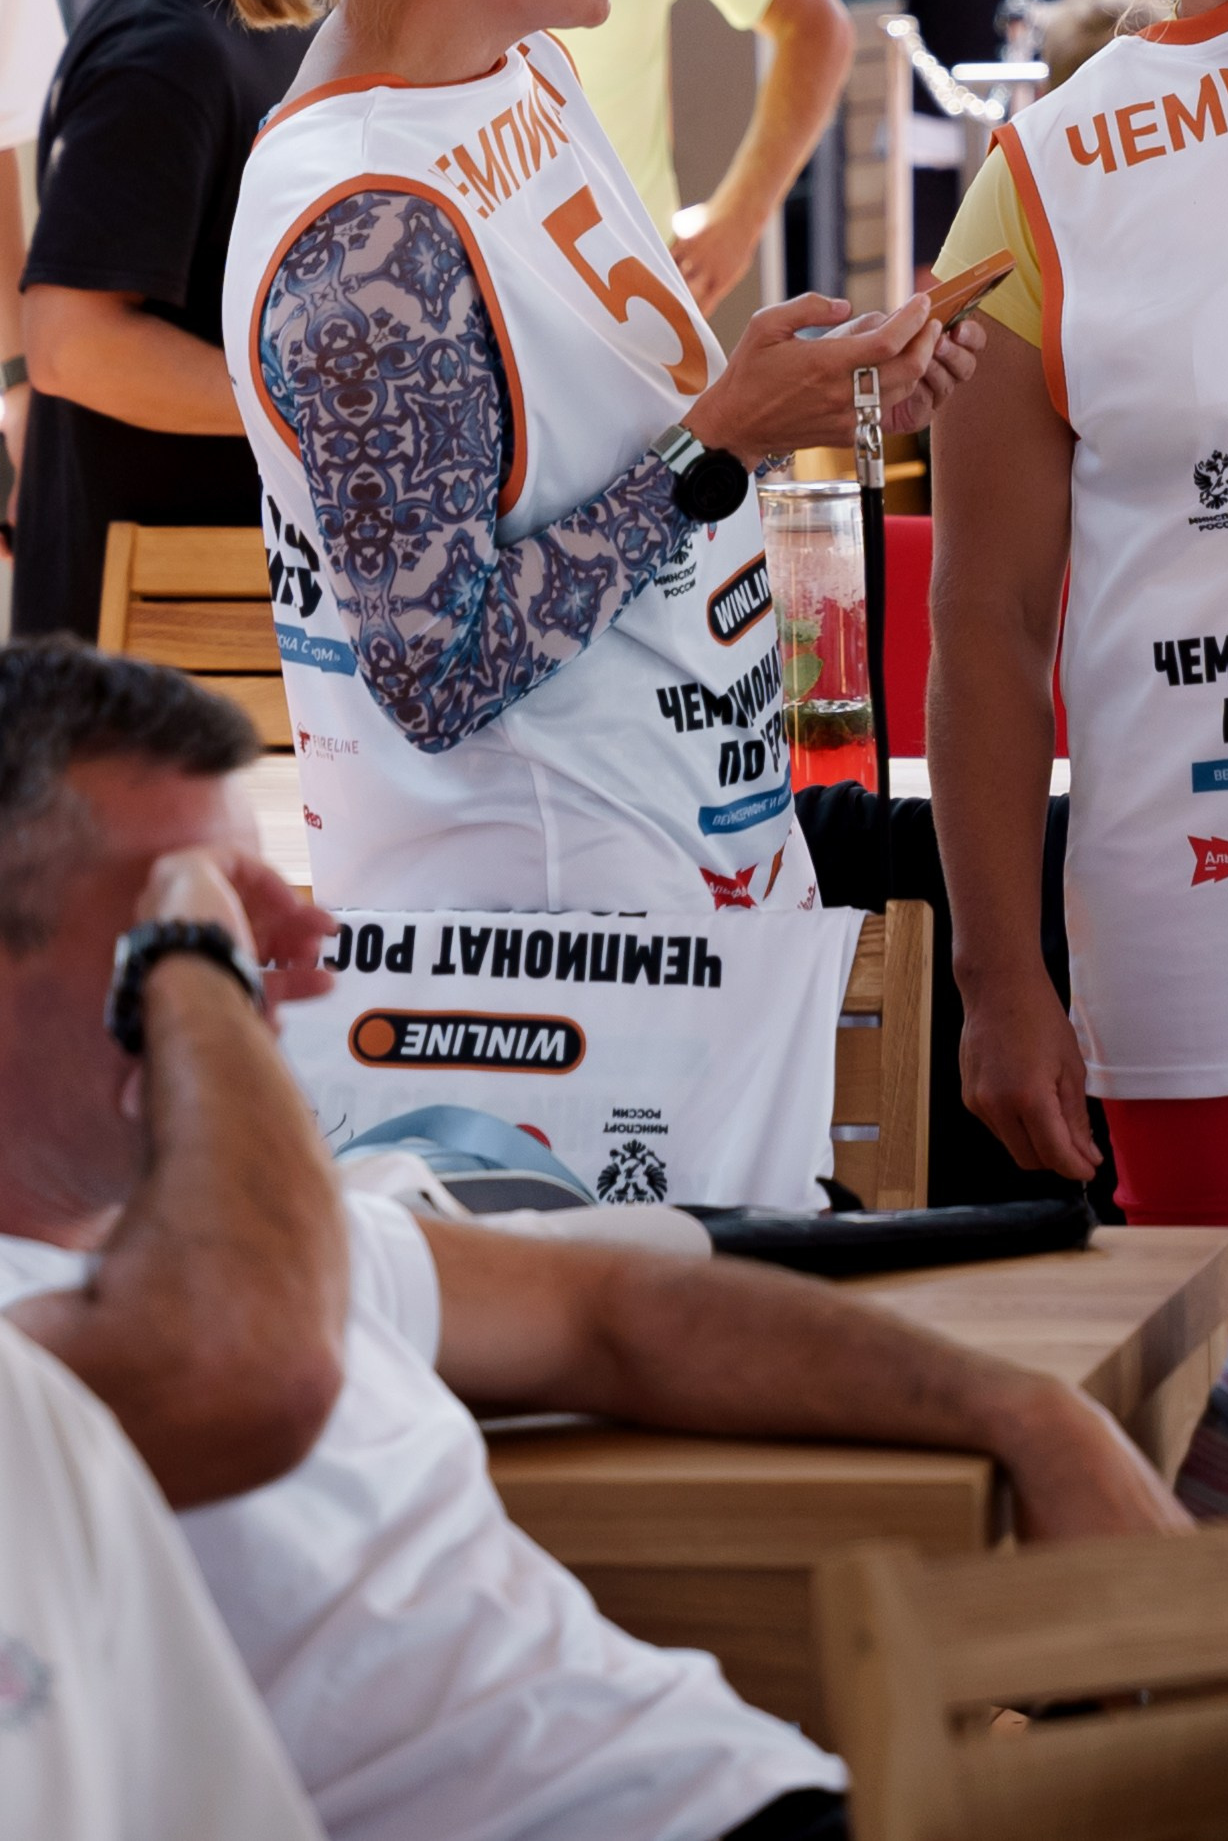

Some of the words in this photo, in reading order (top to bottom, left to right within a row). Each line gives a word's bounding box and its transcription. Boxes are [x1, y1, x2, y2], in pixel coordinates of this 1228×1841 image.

[541, 184, 708, 396] 5
[718, 739, 766, 788] ПО
[431, 925, 722, 989] ЧЕМПИОНАТ
[401, 1022, 567, 1062] WINLINE
[602, 1122, 669, 1136] МИНСПОРТ
[612, 1108, 662, 1120] РОССИИ
